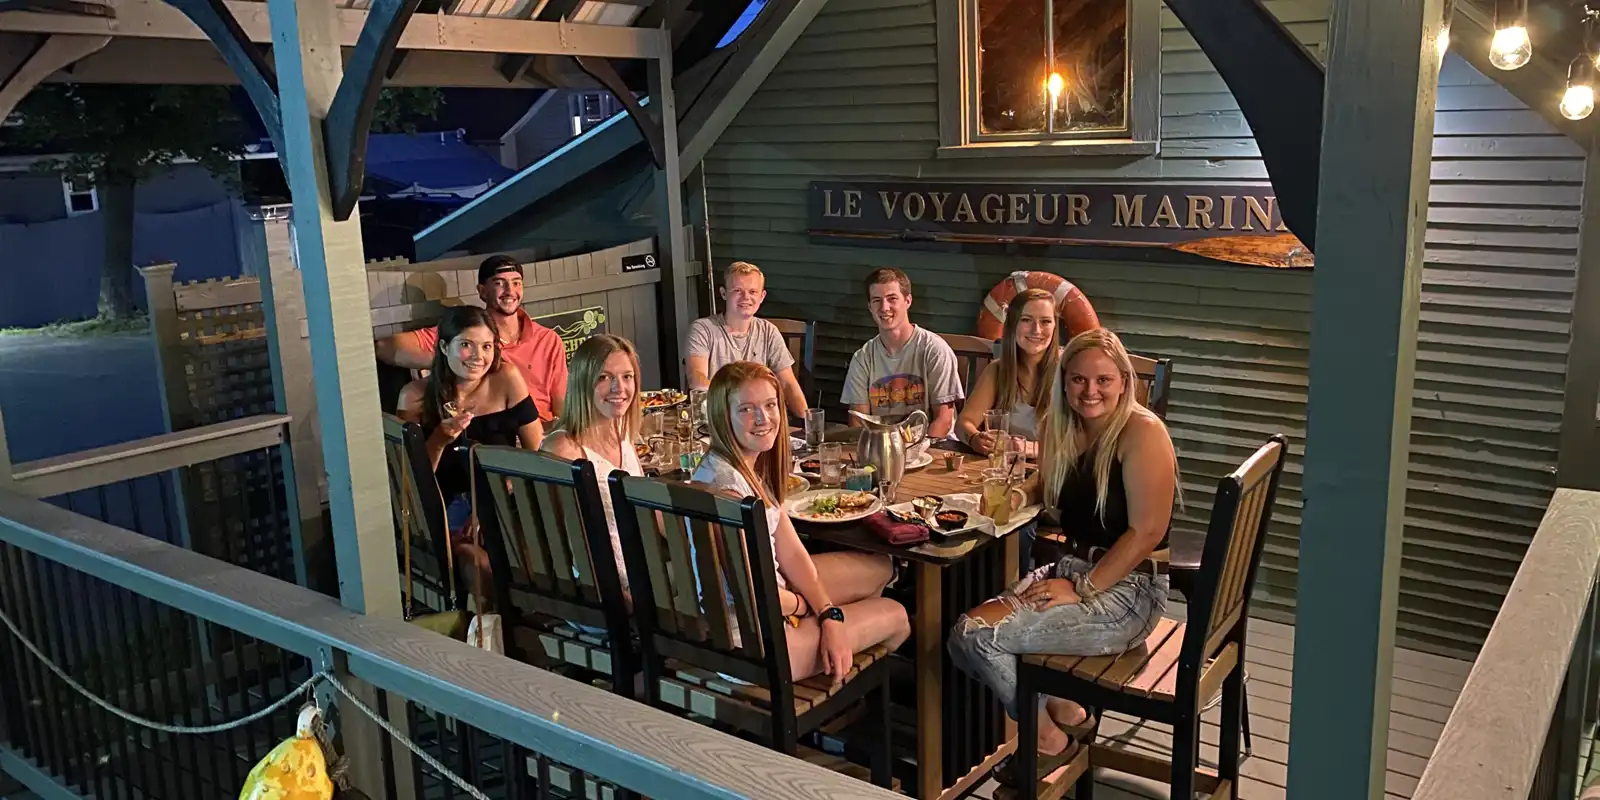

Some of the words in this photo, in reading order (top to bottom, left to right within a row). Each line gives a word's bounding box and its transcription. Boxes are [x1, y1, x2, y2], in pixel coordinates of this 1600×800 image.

[823, 189, 862, 218] LE
[878, 191, 1092, 226] VOYAGEUR
[1112, 194, 1288, 232] MARIN
